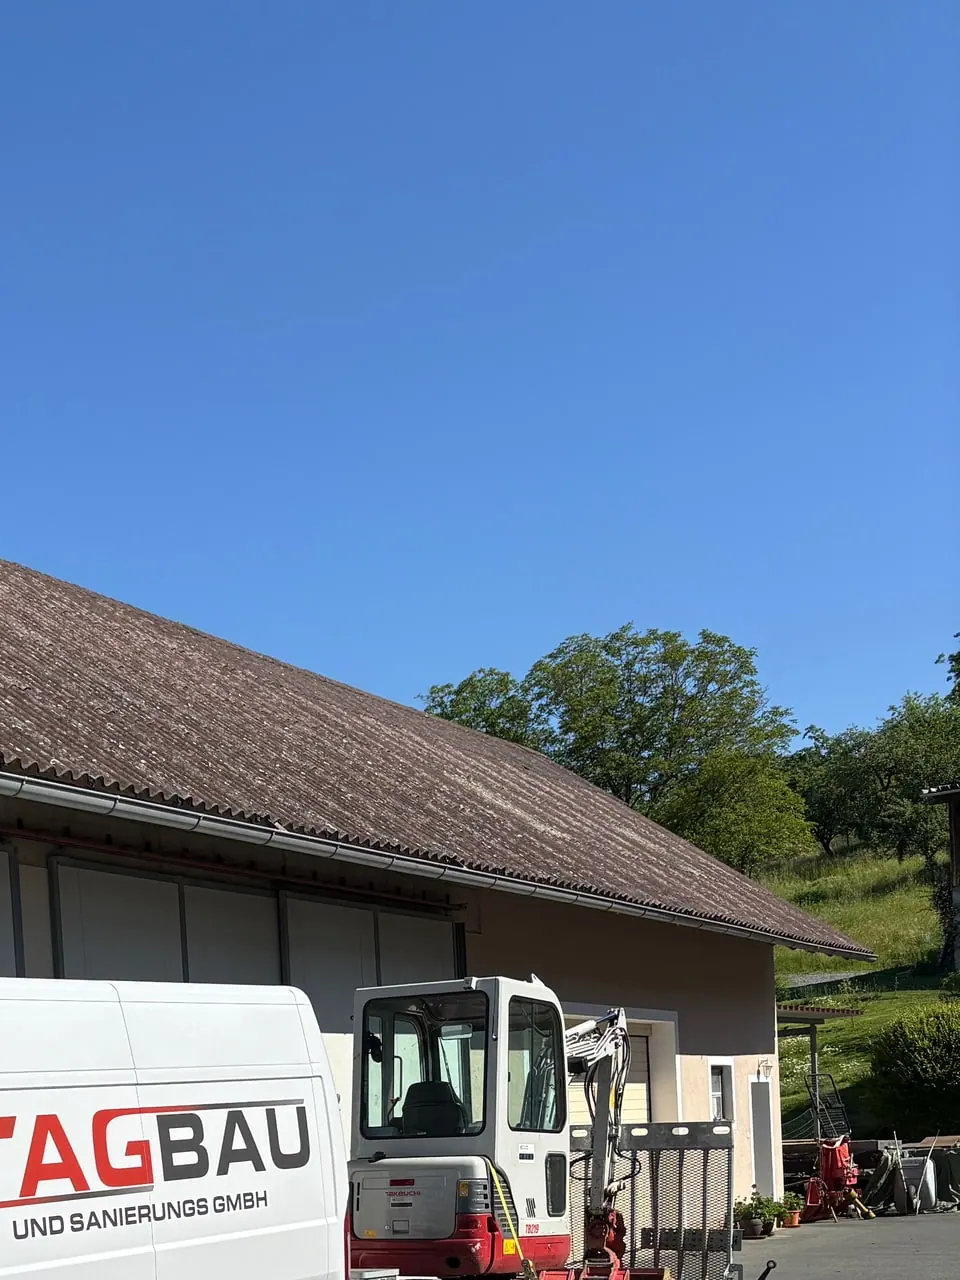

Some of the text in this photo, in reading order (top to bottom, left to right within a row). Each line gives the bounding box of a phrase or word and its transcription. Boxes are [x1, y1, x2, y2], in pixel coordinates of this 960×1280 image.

[12, 1190, 268, 1240] UND SANIERUNGS GMBH
